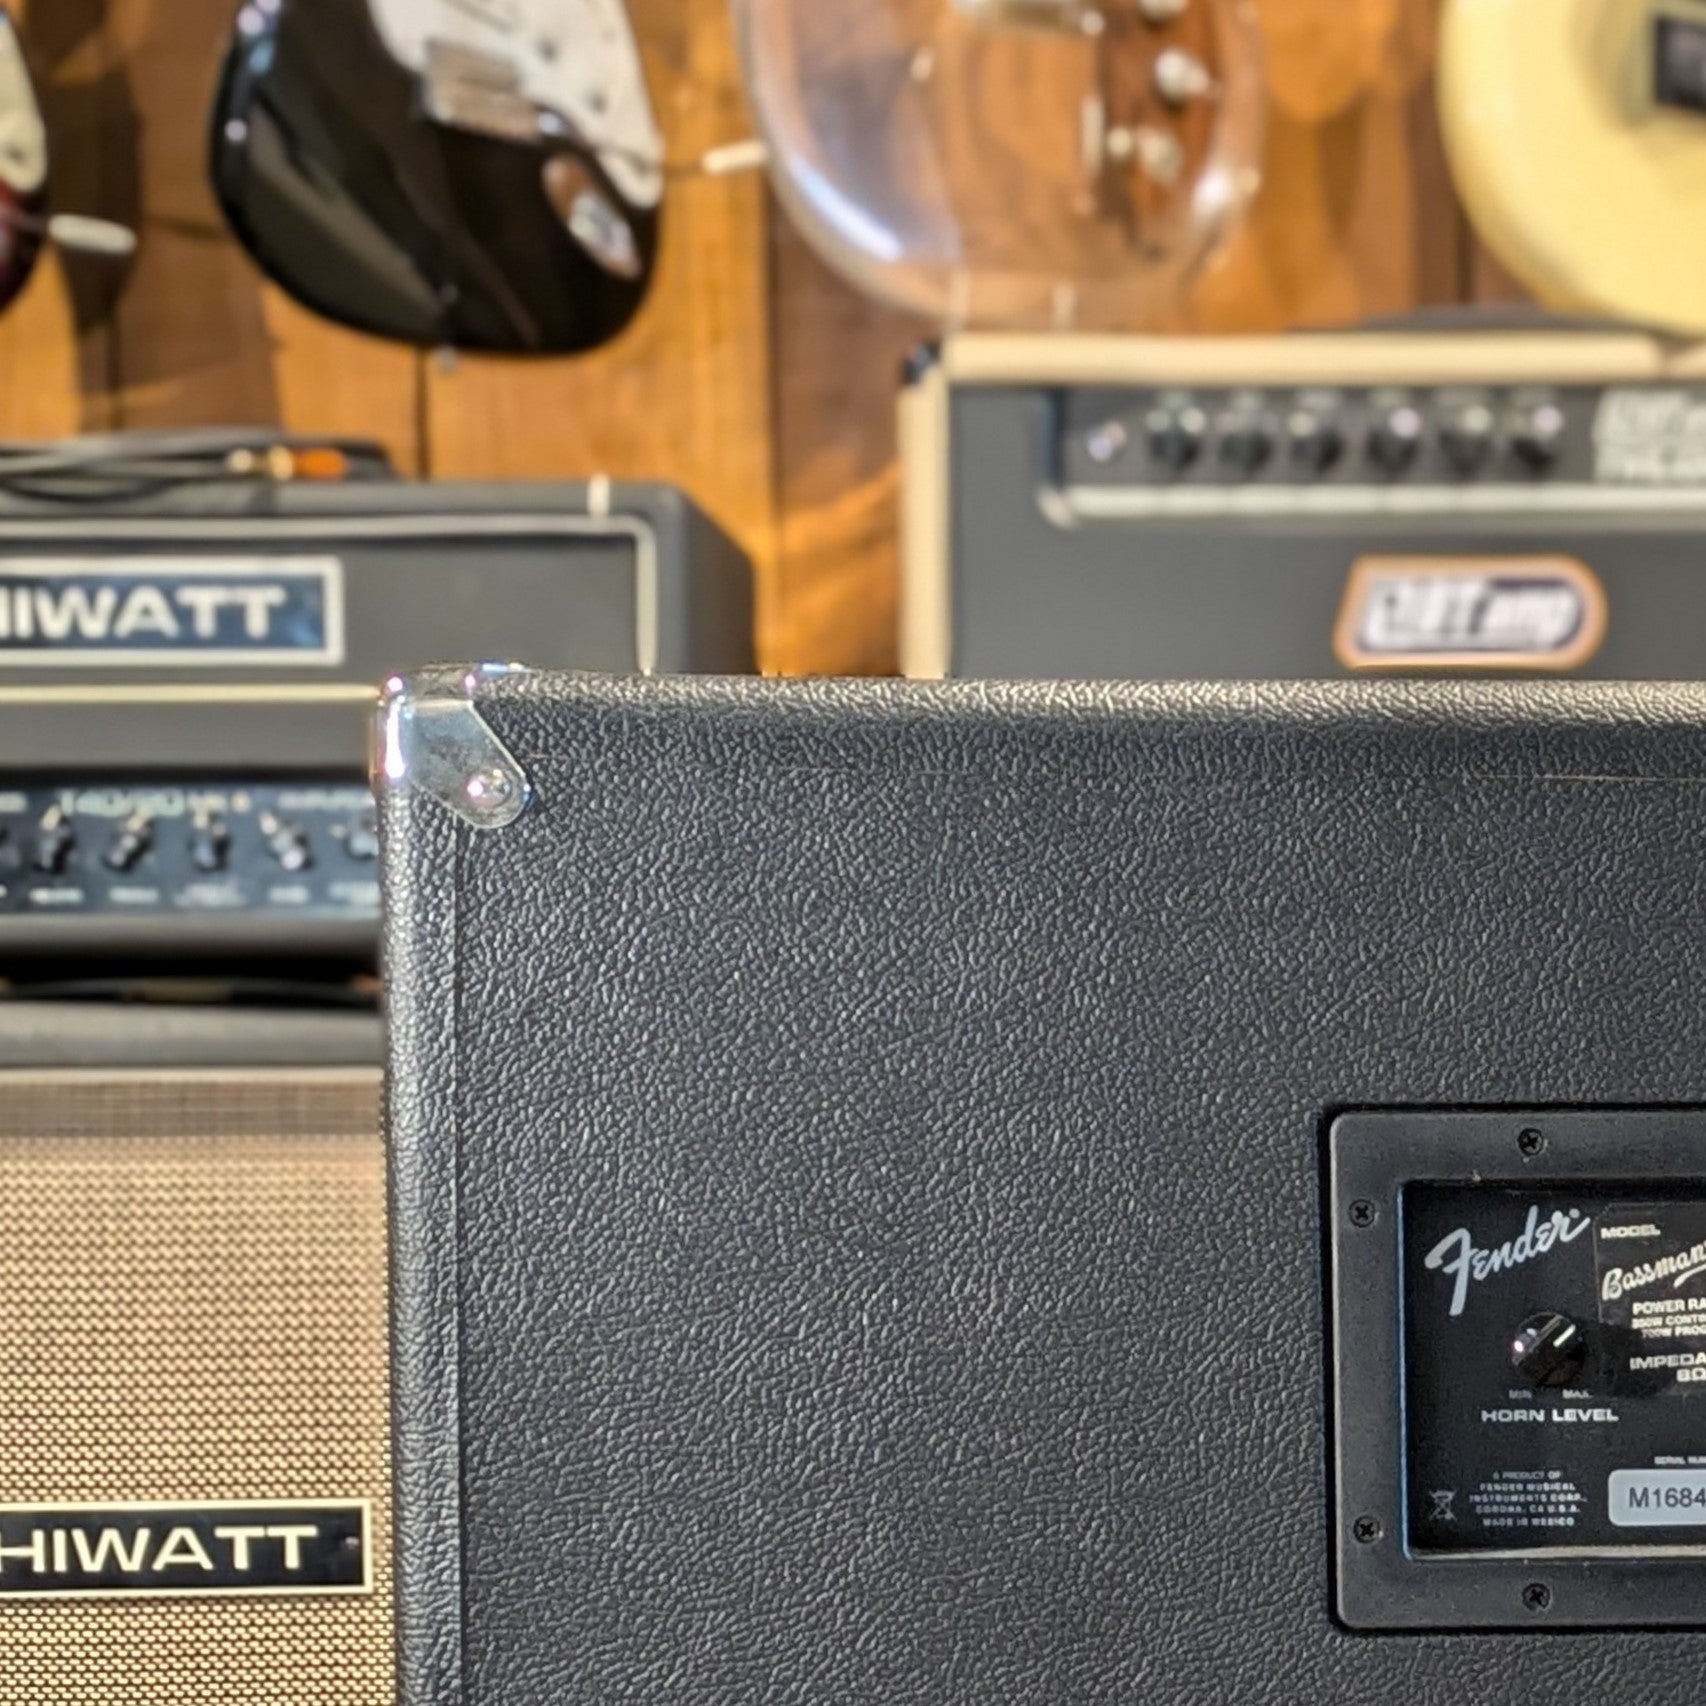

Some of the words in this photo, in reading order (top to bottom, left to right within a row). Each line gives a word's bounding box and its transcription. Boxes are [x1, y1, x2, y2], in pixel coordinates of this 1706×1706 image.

[1601, 1224, 1662, 1239] MODEL
[1424, 1204, 1591, 1317] Fender
[1632, 1299, 1685, 1315] POWER
[1481, 1409, 1545, 1422] HORN
[1551, 1408, 1619, 1422] LEVEL
